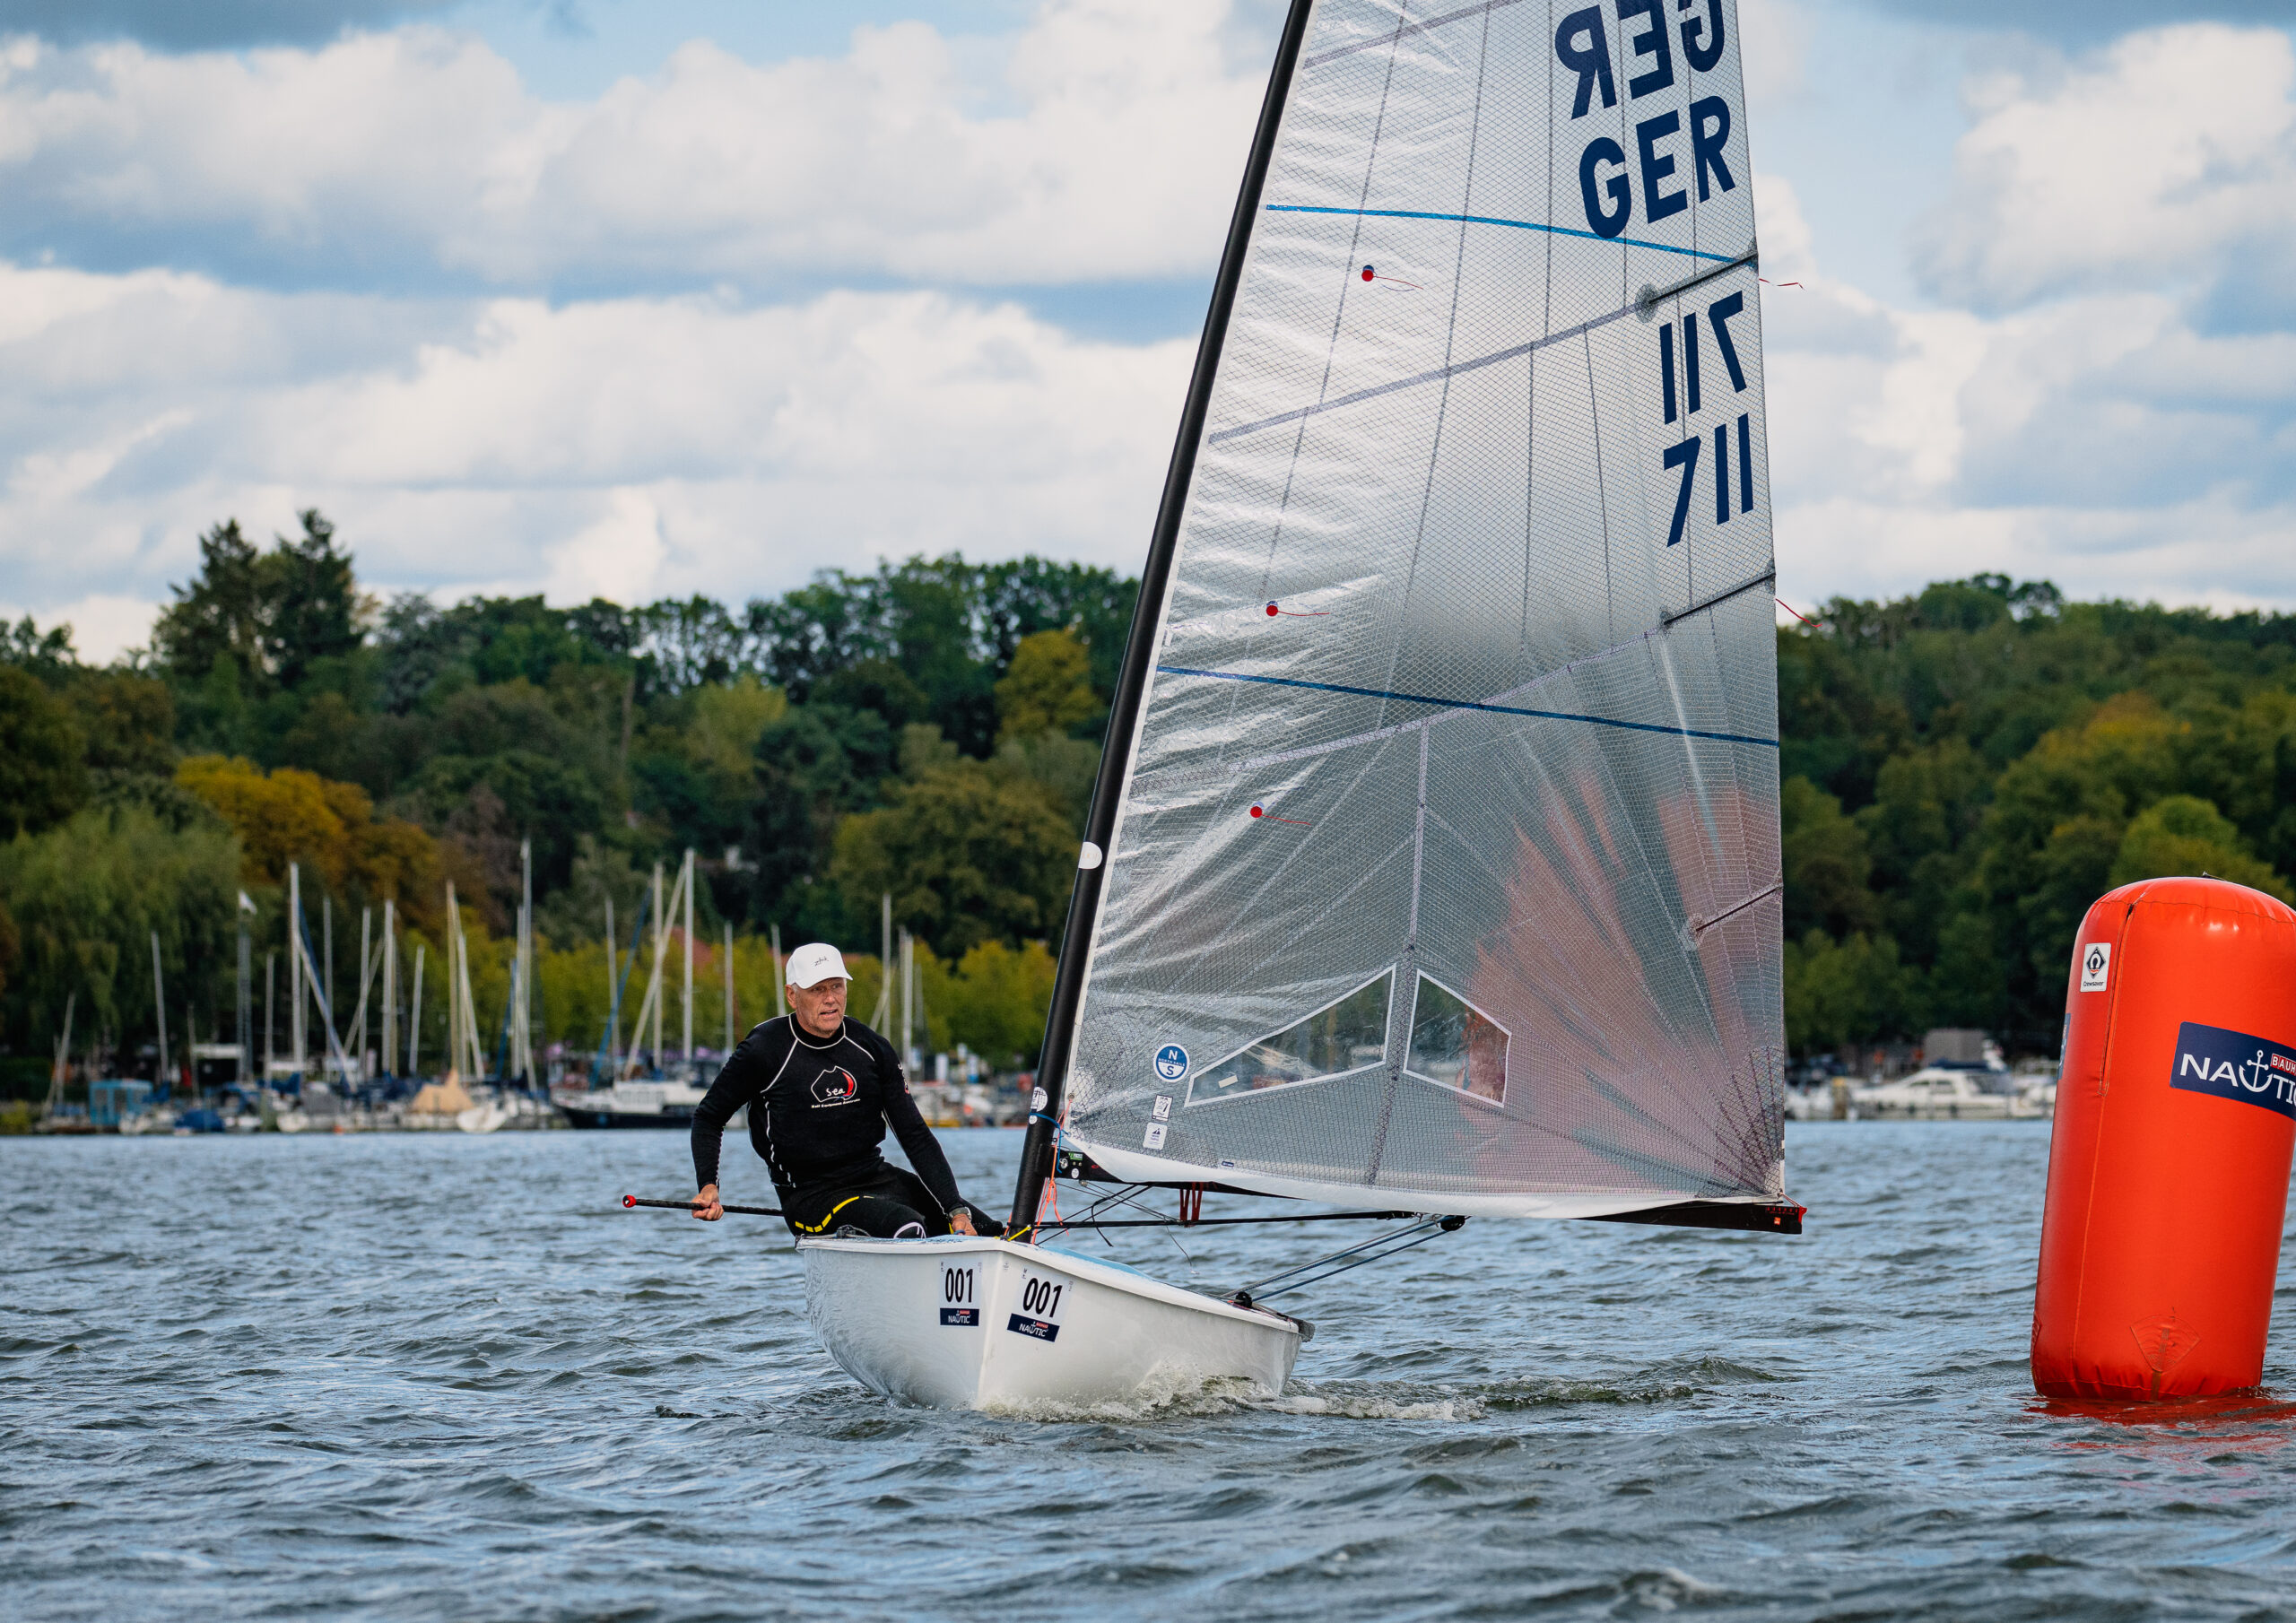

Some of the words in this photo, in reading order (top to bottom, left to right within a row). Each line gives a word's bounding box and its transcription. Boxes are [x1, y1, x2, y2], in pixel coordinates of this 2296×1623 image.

[1579, 95, 1736, 239] GER
[1664, 412, 1754, 548] 711
[1166, 1065, 1175, 1076] S
[1169, 1049, 1178, 1061] N
[2179, 1050, 2296, 1107] NAUTI
[945, 1268, 973, 1303] 001
[1022, 1278, 1063, 1318] 001
[948, 1312, 971, 1324] NAUTIC
[1019, 1322, 1048, 1337] NAUTIC
